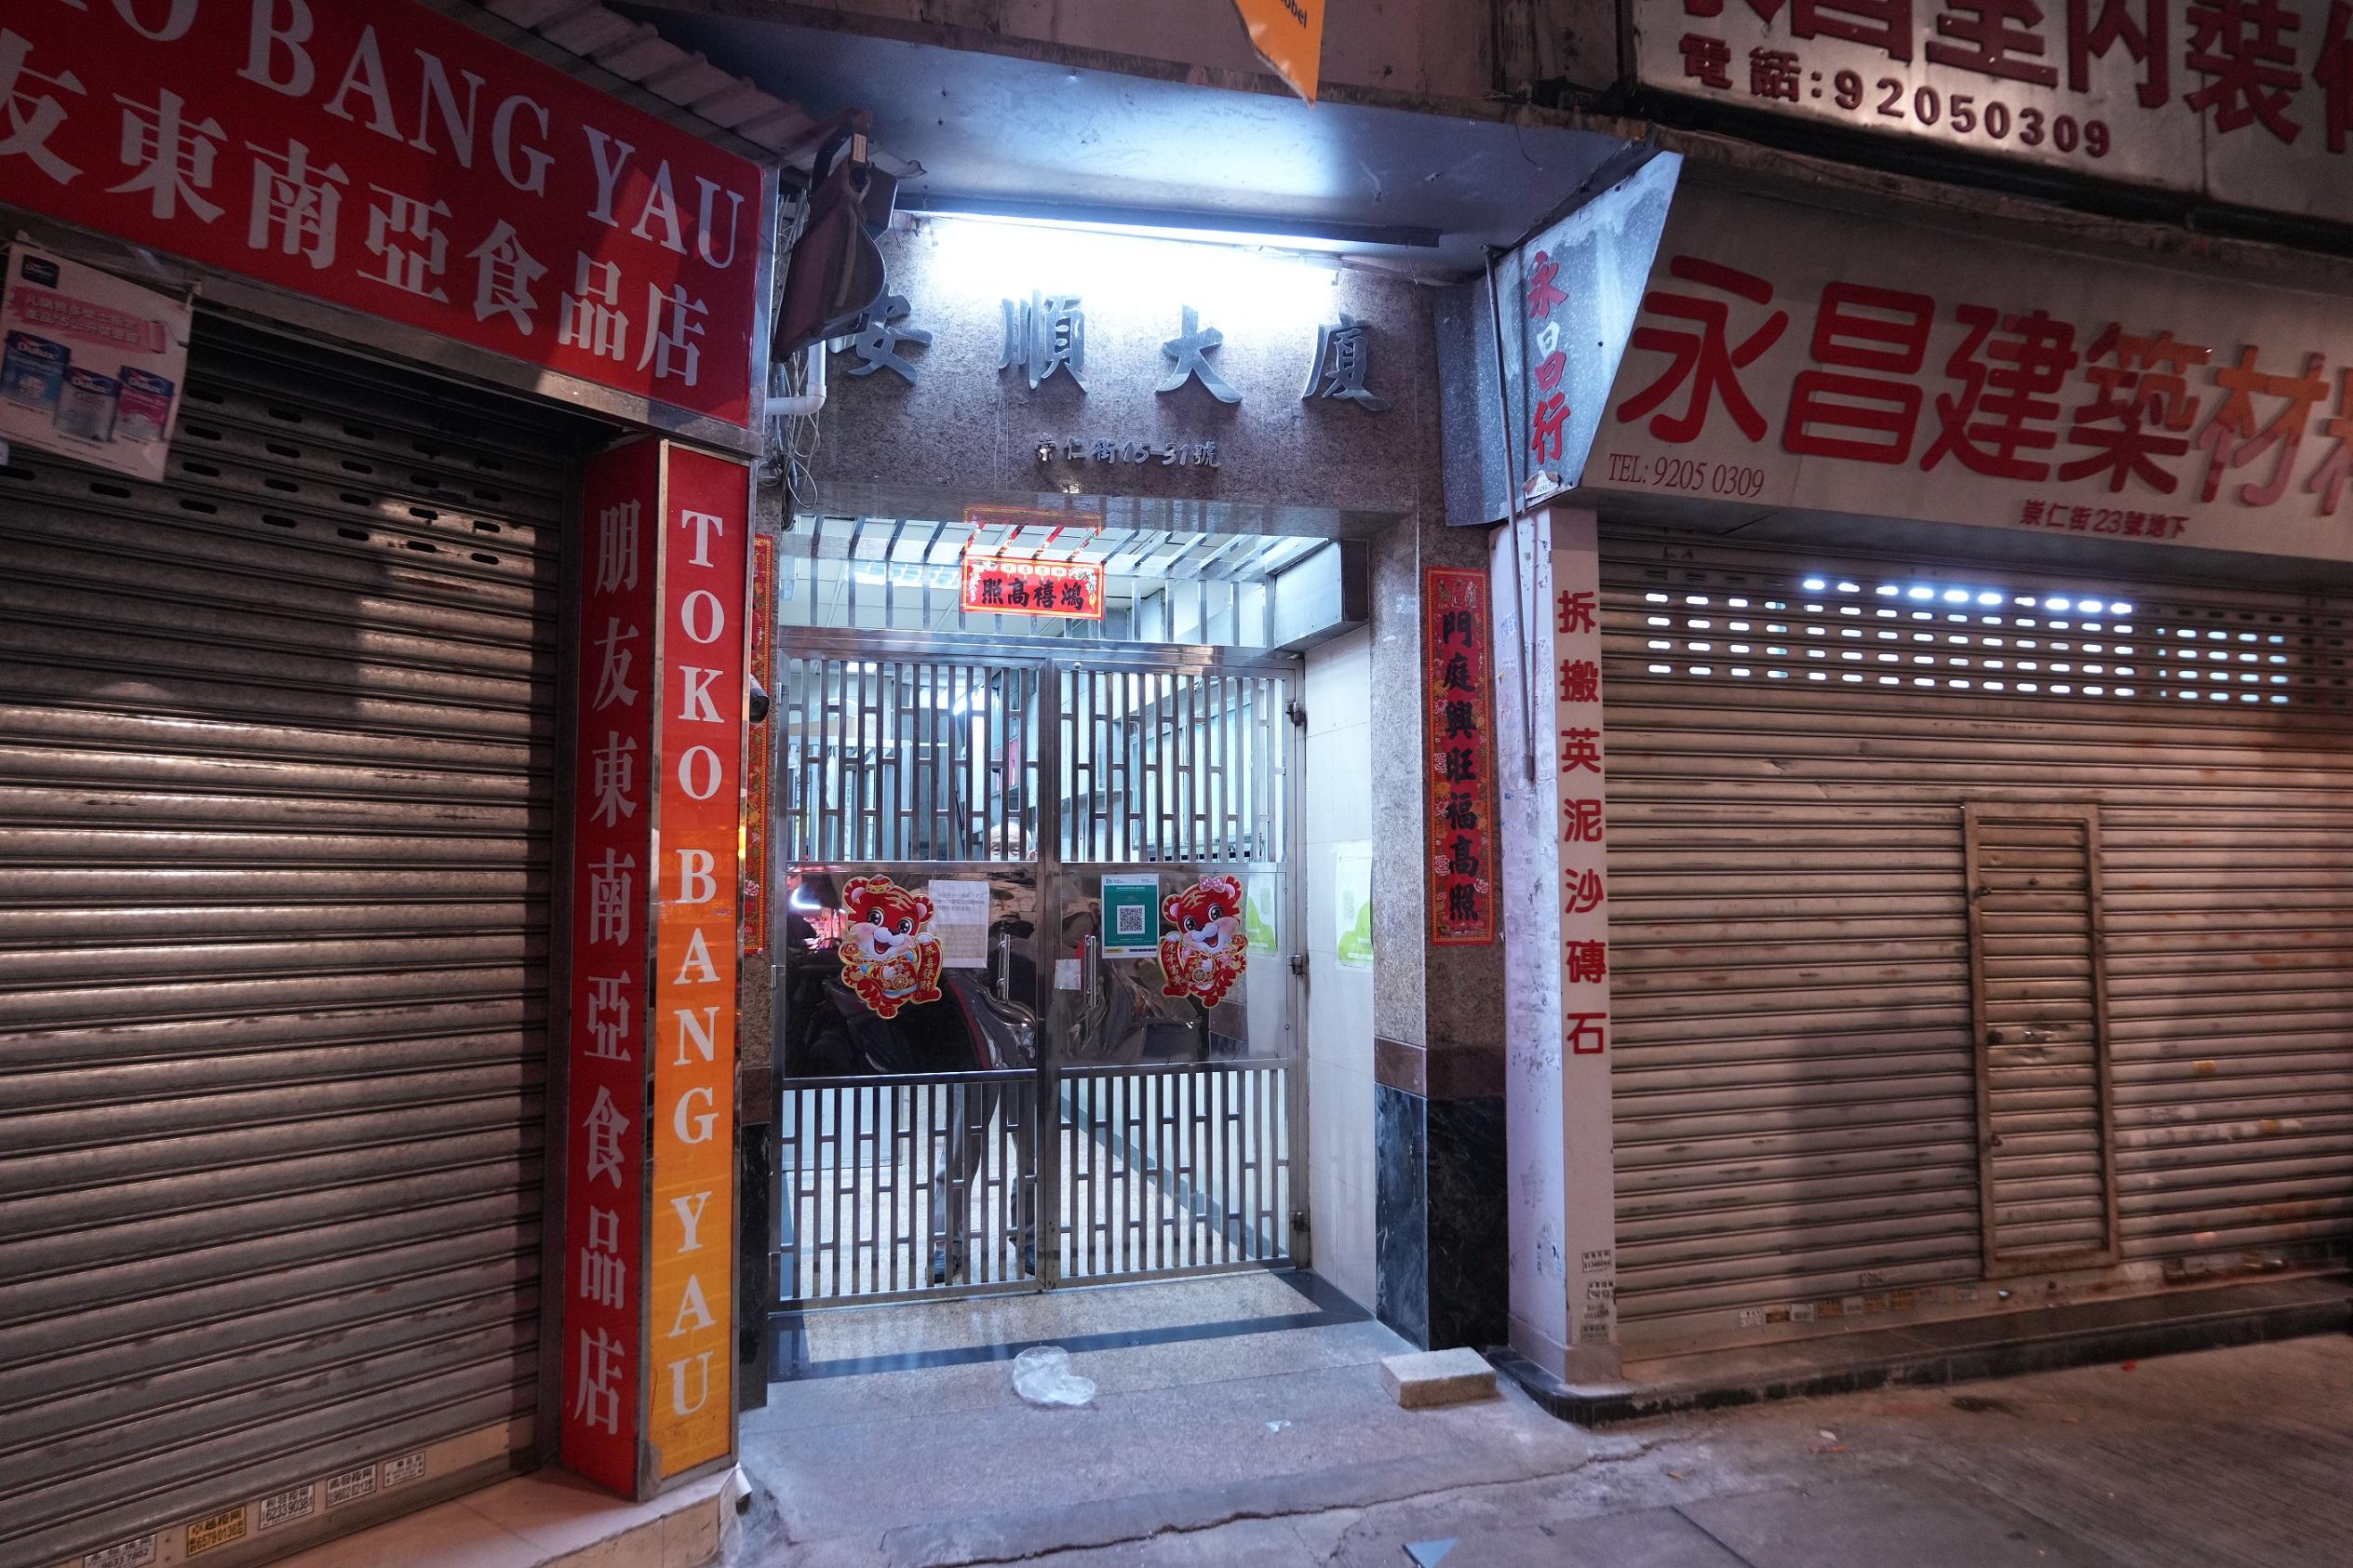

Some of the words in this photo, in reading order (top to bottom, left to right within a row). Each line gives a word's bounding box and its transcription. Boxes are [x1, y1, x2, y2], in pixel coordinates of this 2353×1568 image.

[236, 0, 556, 198] BANG
[582, 124, 746, 270] YAU
[831, 283, 1392, 411] 安順大廈
[1608, 453, 1648, 484] TEL:
[1651, 456, 1708, 490] 9205
[1712, 463, 1766, 498] 0309
[678, 509, 726, 800] TOKO
[1557, 590, 1607, 1055] 拆搬英泥沙磚石
[574, 498, 642, 1436] 朋友東南亞食品店
[673, 849, 722, 1146] BANG
[668, 1190, 716, 1417] YAU
